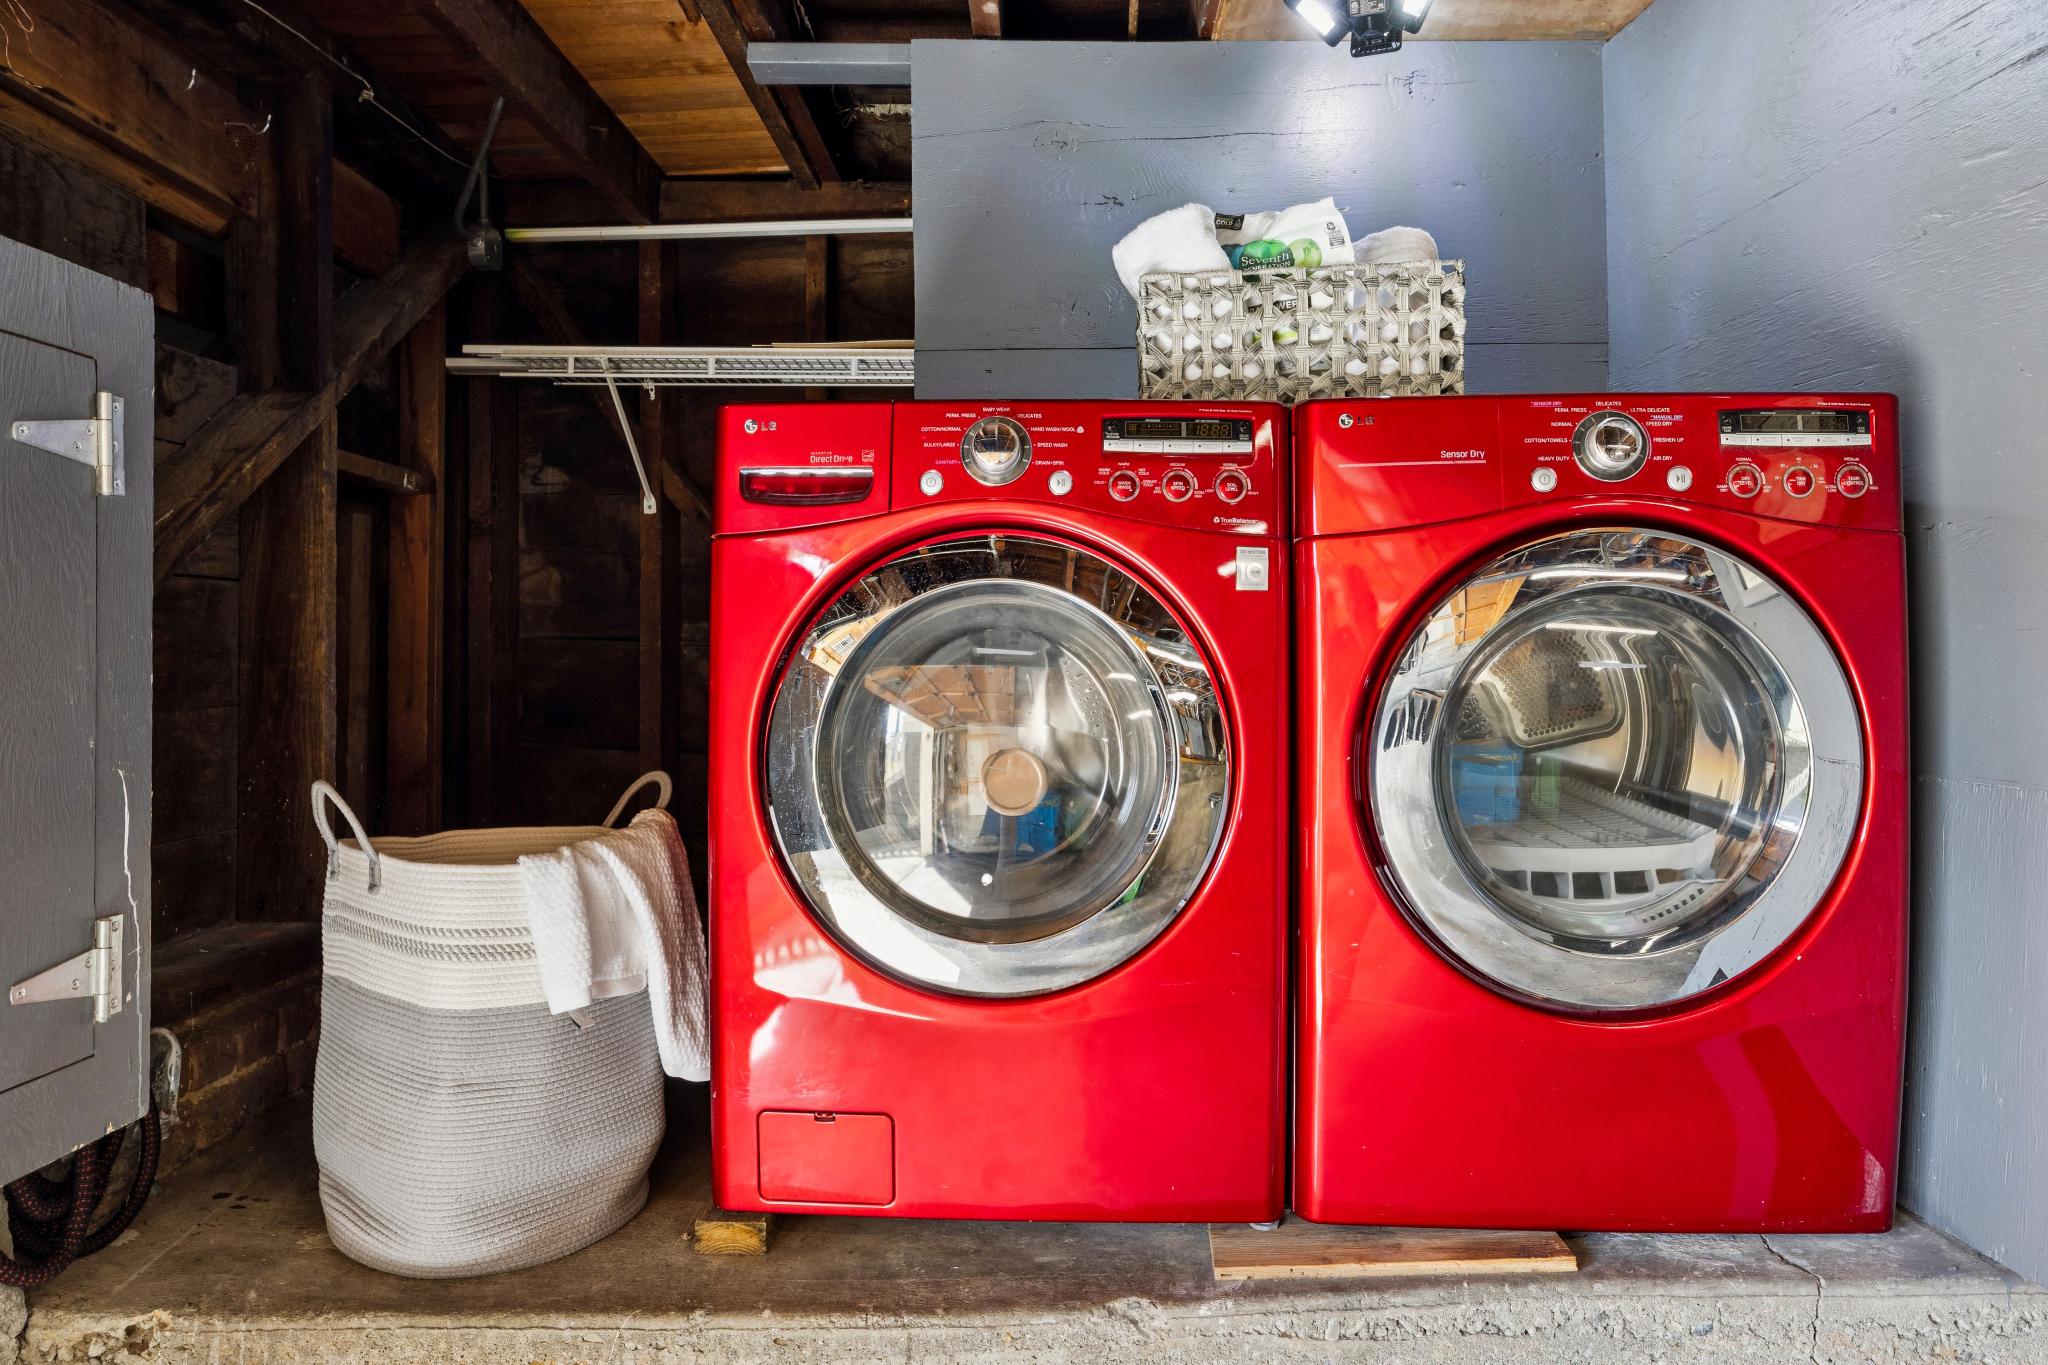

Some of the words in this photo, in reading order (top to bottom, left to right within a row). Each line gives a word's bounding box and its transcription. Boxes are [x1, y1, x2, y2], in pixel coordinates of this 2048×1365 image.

[1241, 253, 1289, 266] Seventh
[810, 455, 833, 463] Direct
[1440, 450, 1468, 458] Sensor
[1470, 450, 1485, 459] Dry
